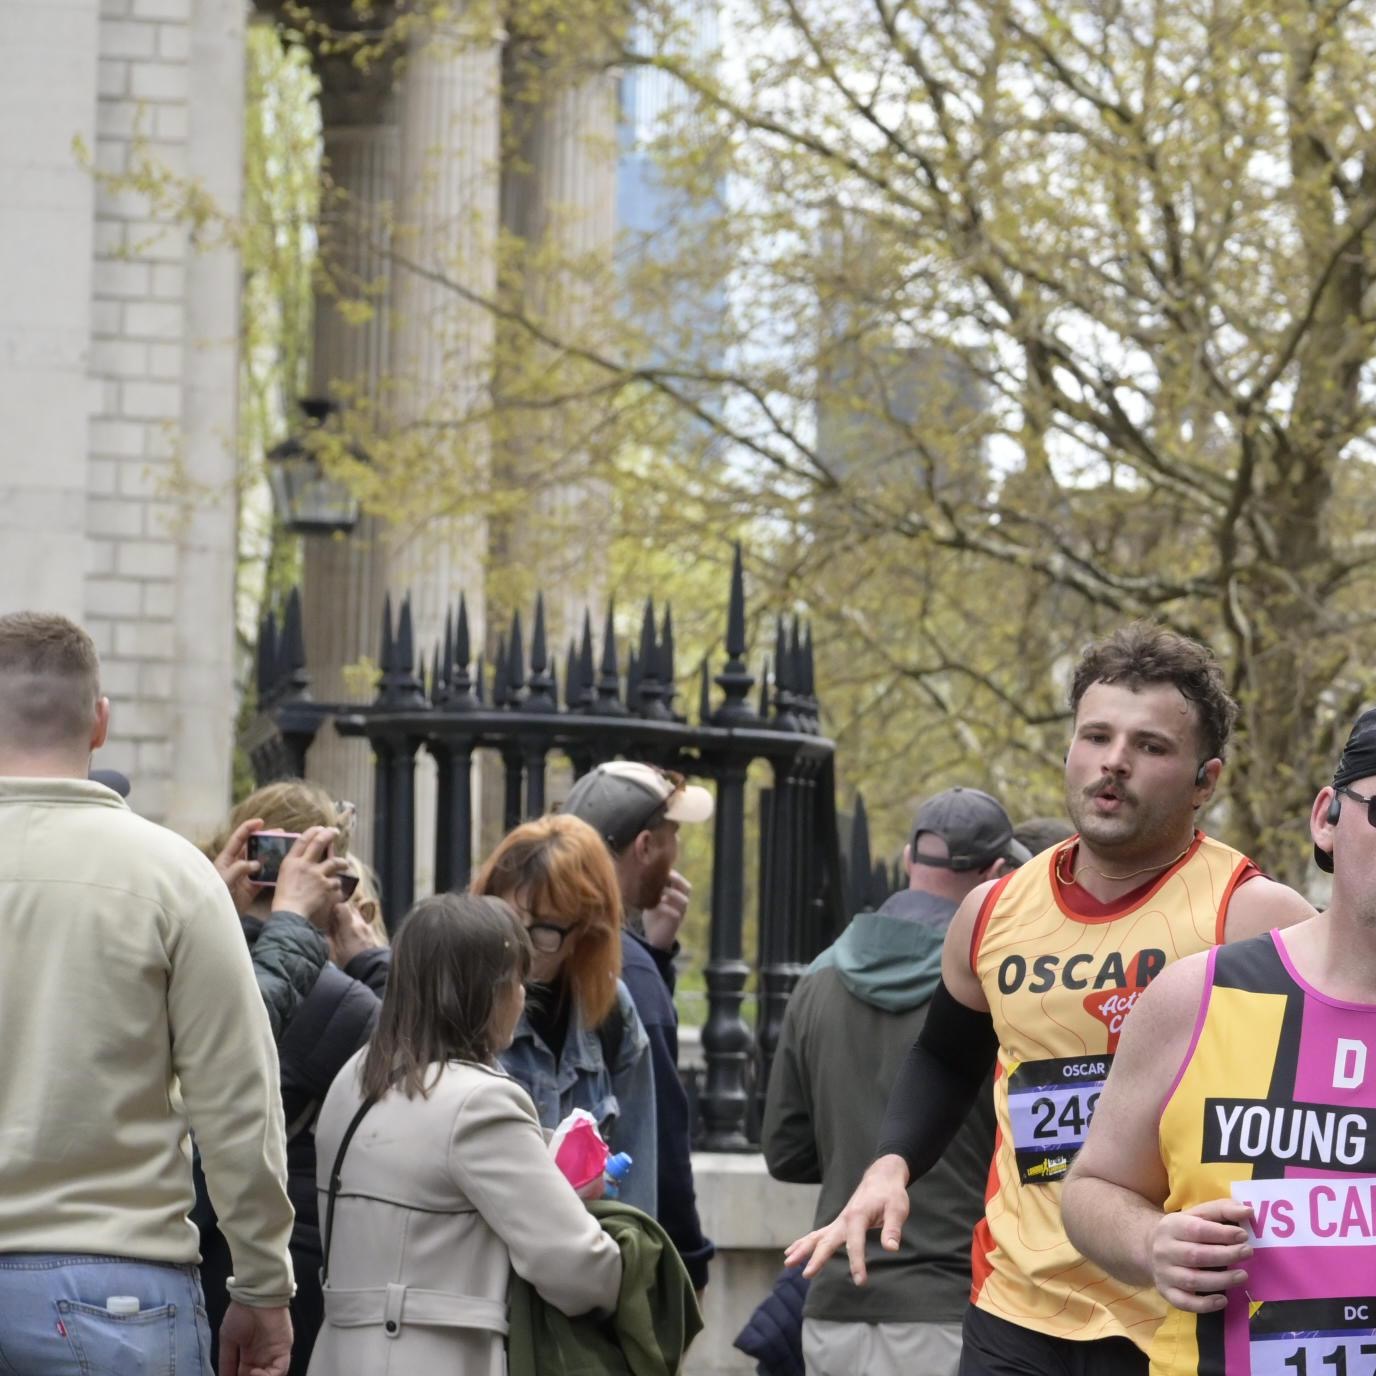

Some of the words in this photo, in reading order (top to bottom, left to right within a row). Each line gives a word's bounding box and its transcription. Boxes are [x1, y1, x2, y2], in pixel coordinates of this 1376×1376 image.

[998, 948, 1167, 995] OSCAR
[1062, 1062, 1106, 1078] OSCAR
[1215, 1105, 1367, 1166] YOUNG
[1242, 1200, 1296, 1239] VS
[1344, 1305, 1369, 1321] DC
